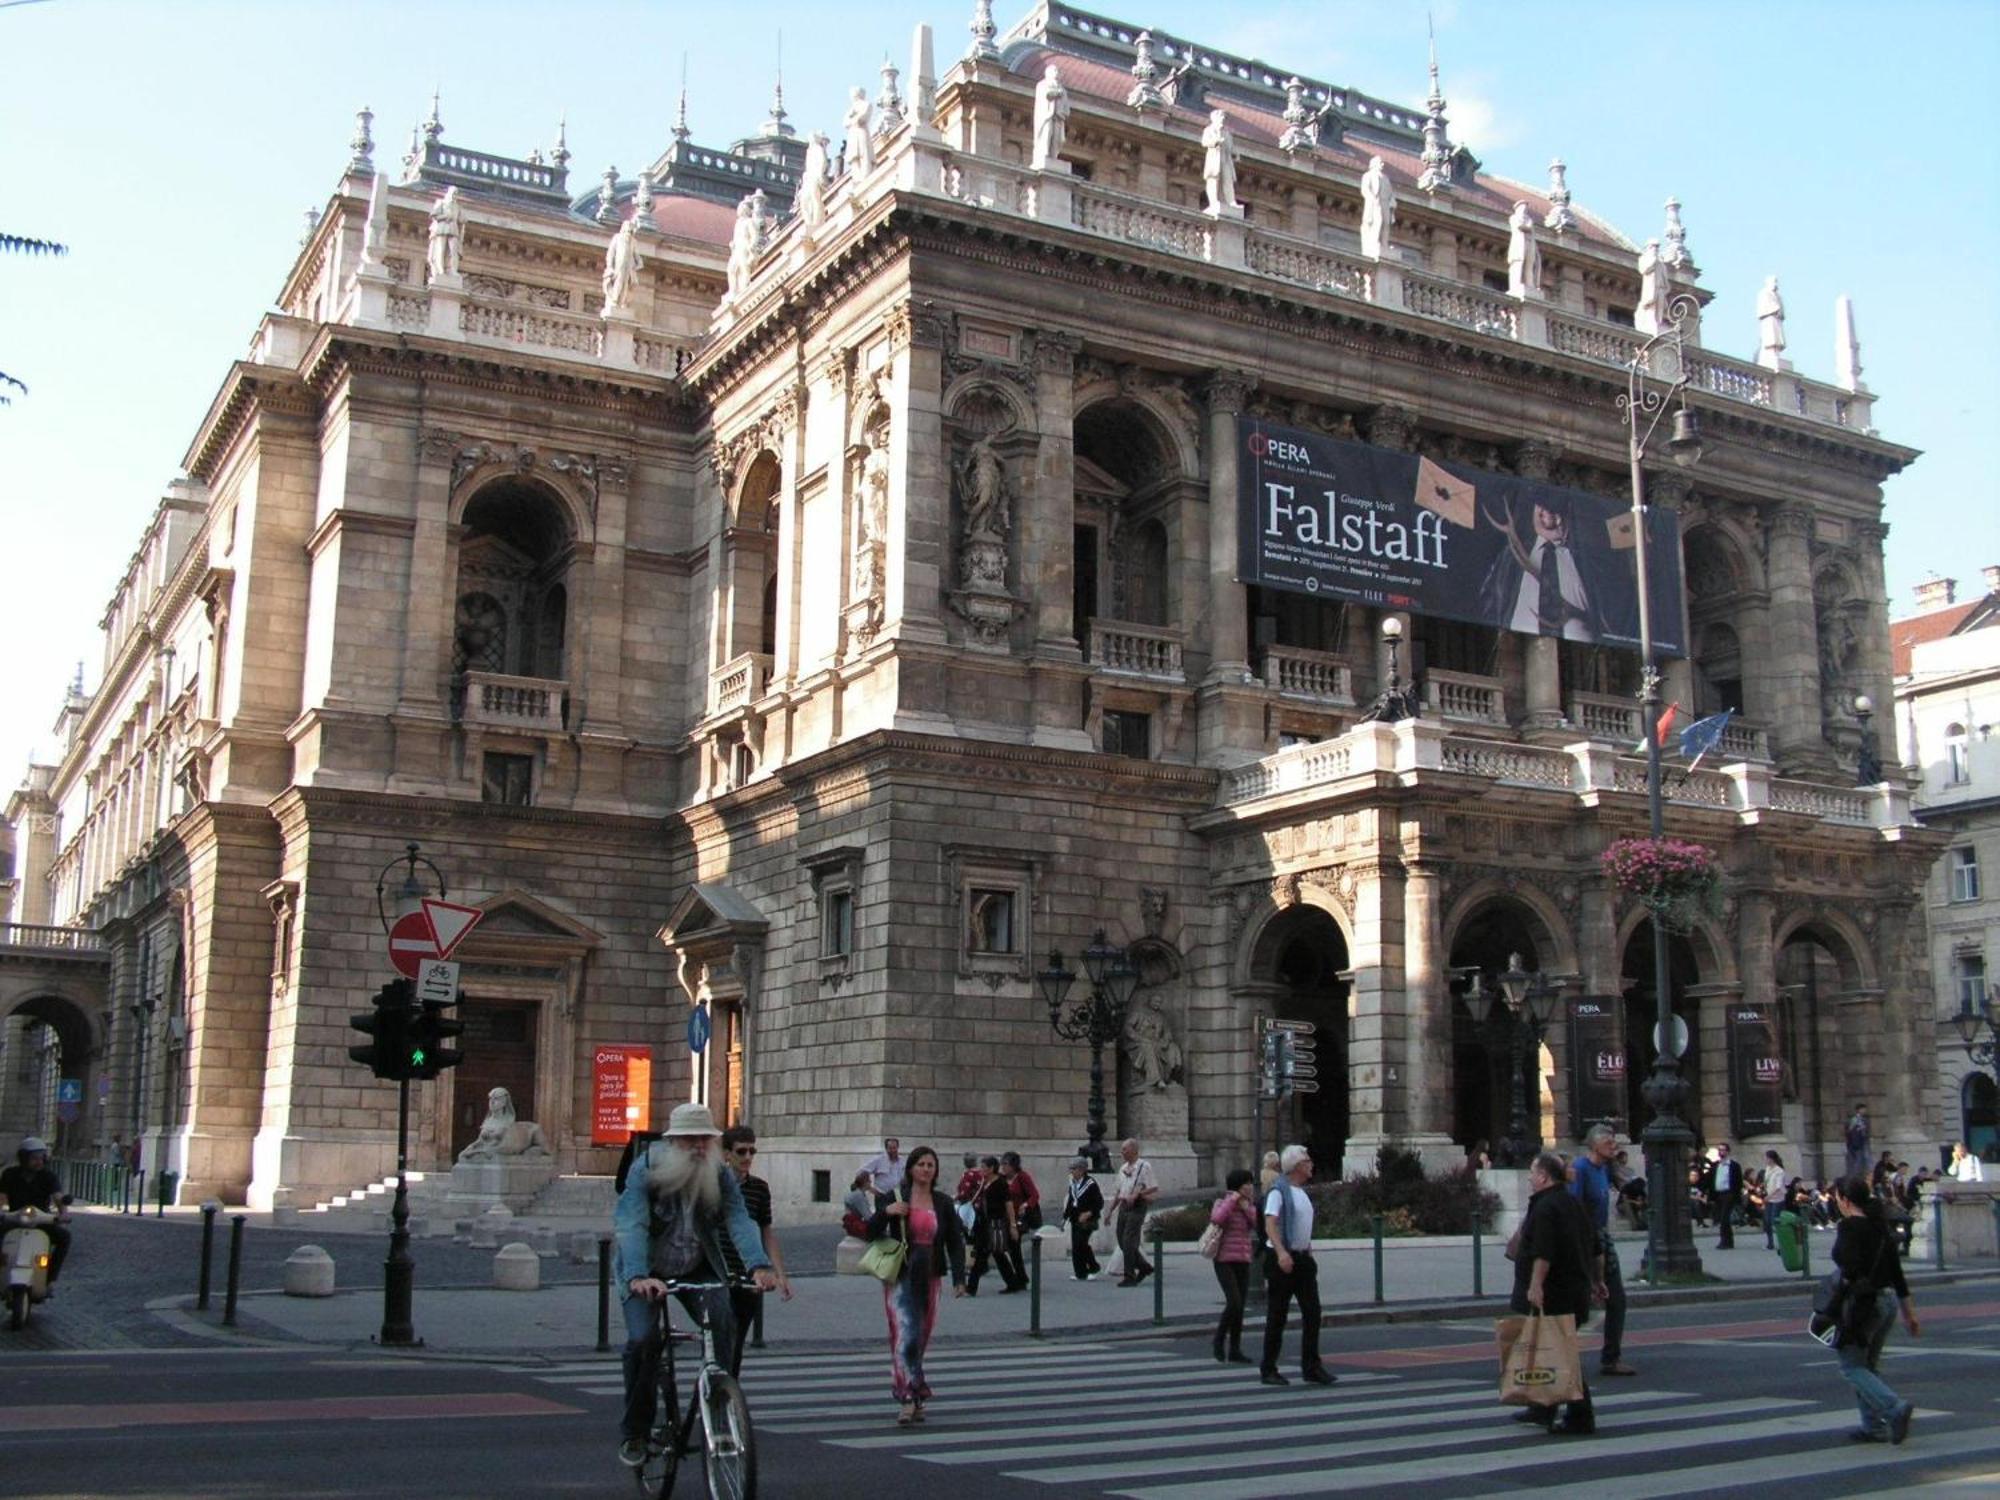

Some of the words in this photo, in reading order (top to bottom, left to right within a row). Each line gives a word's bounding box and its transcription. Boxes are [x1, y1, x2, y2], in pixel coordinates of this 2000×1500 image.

[1249, 433, 1311, 465] OPERA
[1265, 482, 1449, 569] Falstaff
[596, 1053, 624, 1063] OPERA
